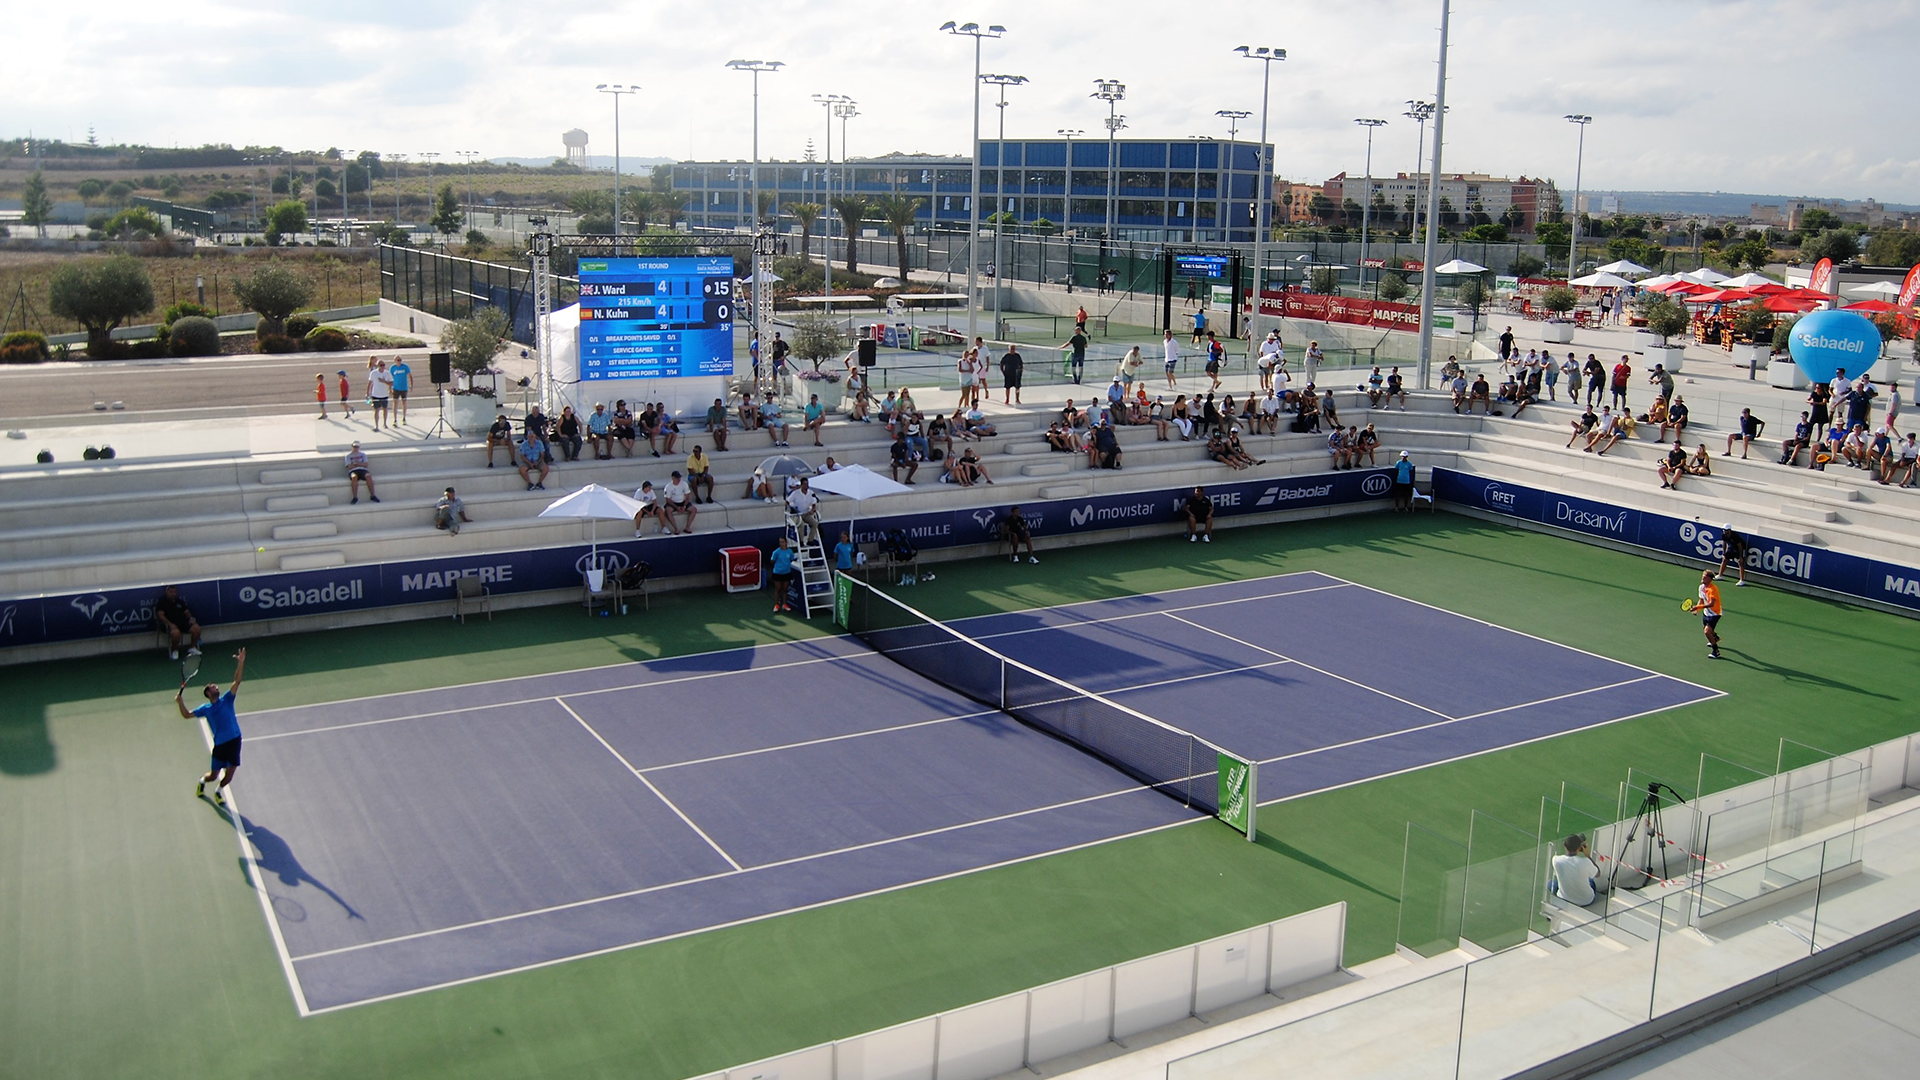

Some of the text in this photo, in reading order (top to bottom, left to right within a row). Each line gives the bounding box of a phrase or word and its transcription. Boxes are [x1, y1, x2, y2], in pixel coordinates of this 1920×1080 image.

[593, 284, 626, 295] J. Ward
[658, 280, 667, 292] 4
[714, 281, 729, 295] 15
[618, 298, 652, 306] 215 Km/h
[658, 304, 667, 316] 4
[1245, 296, 1282, 309] MPFRE
[594, 308, 629, 319] N. Kuhn
[718, 305, 728, 319] 0
[1373, 308, 1419, 324] MAPFRE
[1802, 334, 1864, 354] Sabadell
[1366, 478, 1387, 491] KIA
[1173, 492, 1240, 512] MFRE
[1492, 491, 1516, 504] RFET
[1098, 503, 1155, 520] movistar
[1556, 501, 1627, 533] Drasanvi
[849, 524, 951, 544] ICHA MILLE
[1696, 530, 1812, 579] Saadell
[258, 579, 363, 609] Sabadell
[1226, 768, 1236, 791] ATP
[1226, 765, 1247, 821] CHALLENGER
[1233, 793, 1244, 818] TOUR
